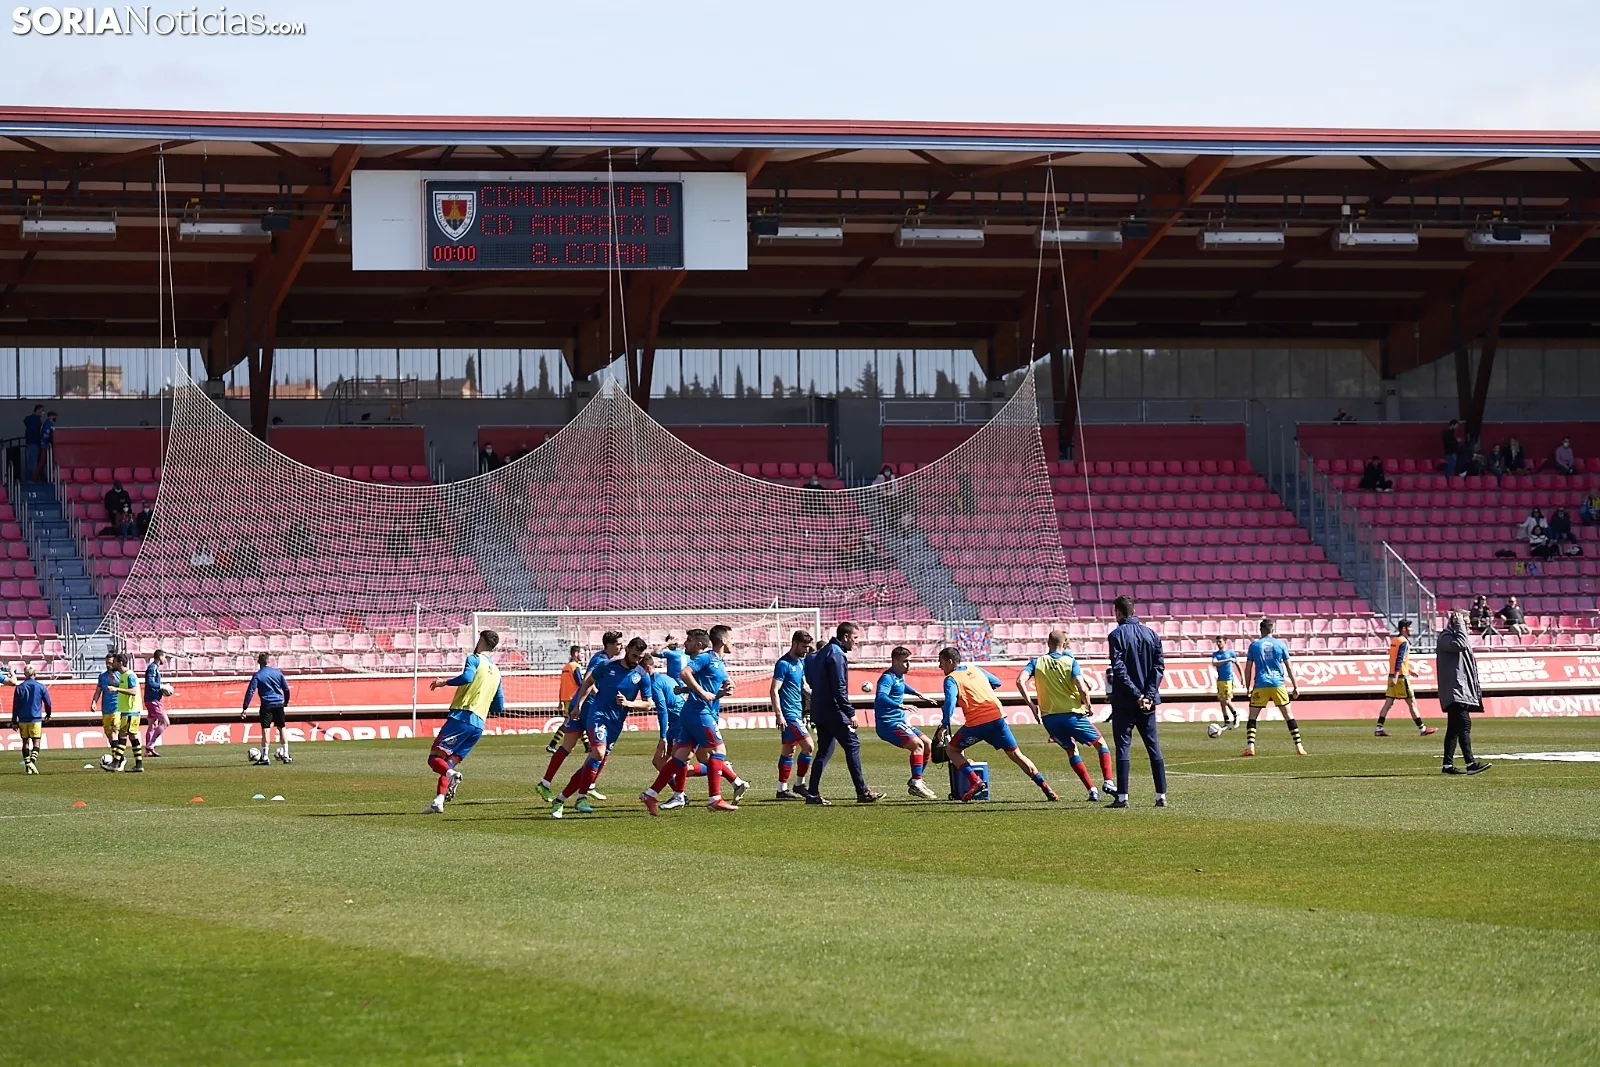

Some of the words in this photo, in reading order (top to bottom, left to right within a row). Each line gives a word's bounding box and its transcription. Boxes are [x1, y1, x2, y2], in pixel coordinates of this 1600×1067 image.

[481, 214, 514, 235] CD
[531, 214, 648, 236] ANDRATX
[432, 245, 477, 262] 00:00
[1363, 659, 1433, 675] PIOS
